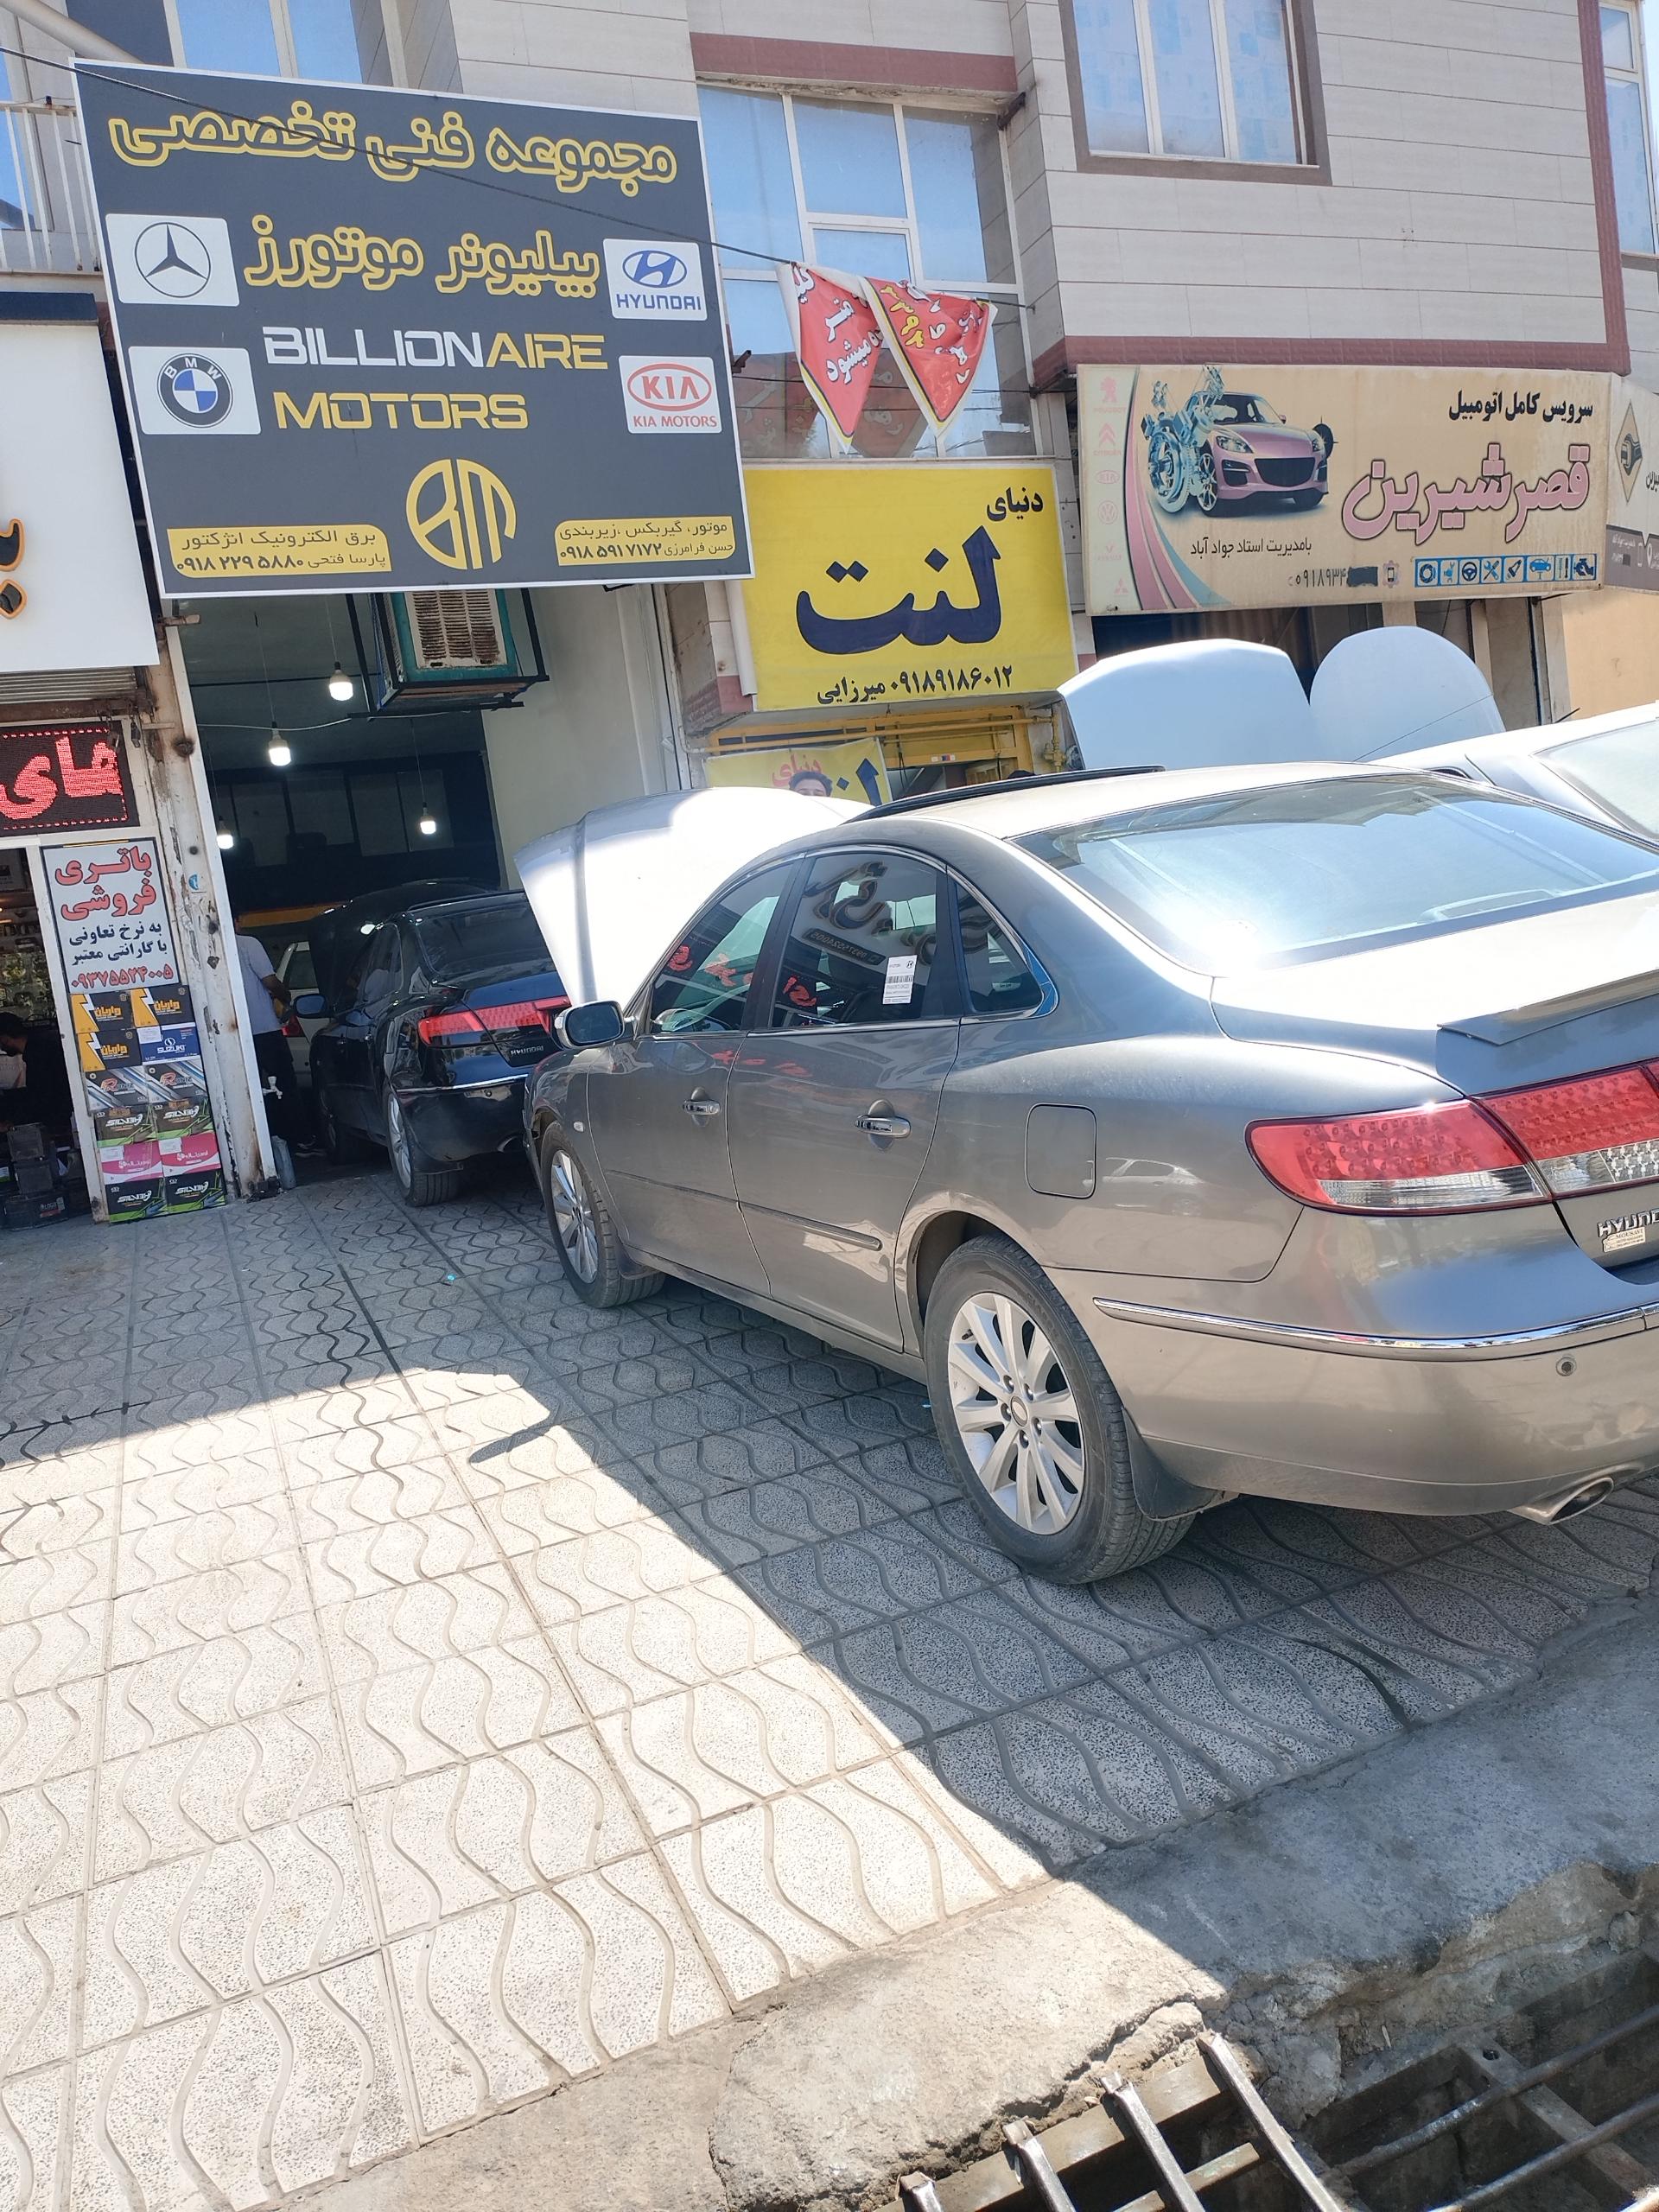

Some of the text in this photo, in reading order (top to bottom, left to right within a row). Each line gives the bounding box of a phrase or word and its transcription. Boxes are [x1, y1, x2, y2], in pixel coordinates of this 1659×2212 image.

[108, 100, 677, 197] مجموعه فنی تخصصی
[244, 214, 601, 299] بیلیونر موتورز
[616, 294, 702, 311] HYUNDAI
[262, 326, 608, 370] BILLIONAIRE
[164, 357, 222, 380] BMW
[641, 375, 700, 400] KIA
[273, 391, 529, 429] MOTORS
[1449, 389, 1593, 423] سرویس کامل اتومبیل
[633, 416, 718, 428] KIA MOTORS
[987, 487, 1044, 522] دنیای
[182, 530, 376, 550] برق الکترونیک انژکتور
[626, 522, 683, 537] گیربکس
[709, 544, 734, 555] حسن
[1191, 537, 1209, 559] آباد
[1211, 540, 1235, 558] جواد
[1236, 538, 1263, 554] استاد
[308, 554, 345, 569] فتحی
[349, 553, 385, 568] پارسا
[797, 525, 1001, 655] لنت
[817, 664, 1012, 704] میرزایی ۰۹۱۸۹۱۸۶۰۱۲
[55, 845, 152, 886] باتری
[60, 878, 156, 921] فروشی
[69, 921, 162, 946] به نرخ تعاونی
[72, 939, 168, 966] با گارانتی معتبر
[71, 963, 175, 989] ۰۹۳۷۵۵۲۴۰۰۵
[157, 1045, 186, 1053] SUZUKI
[511, 1046, 544, 1055] HYUNDAI
